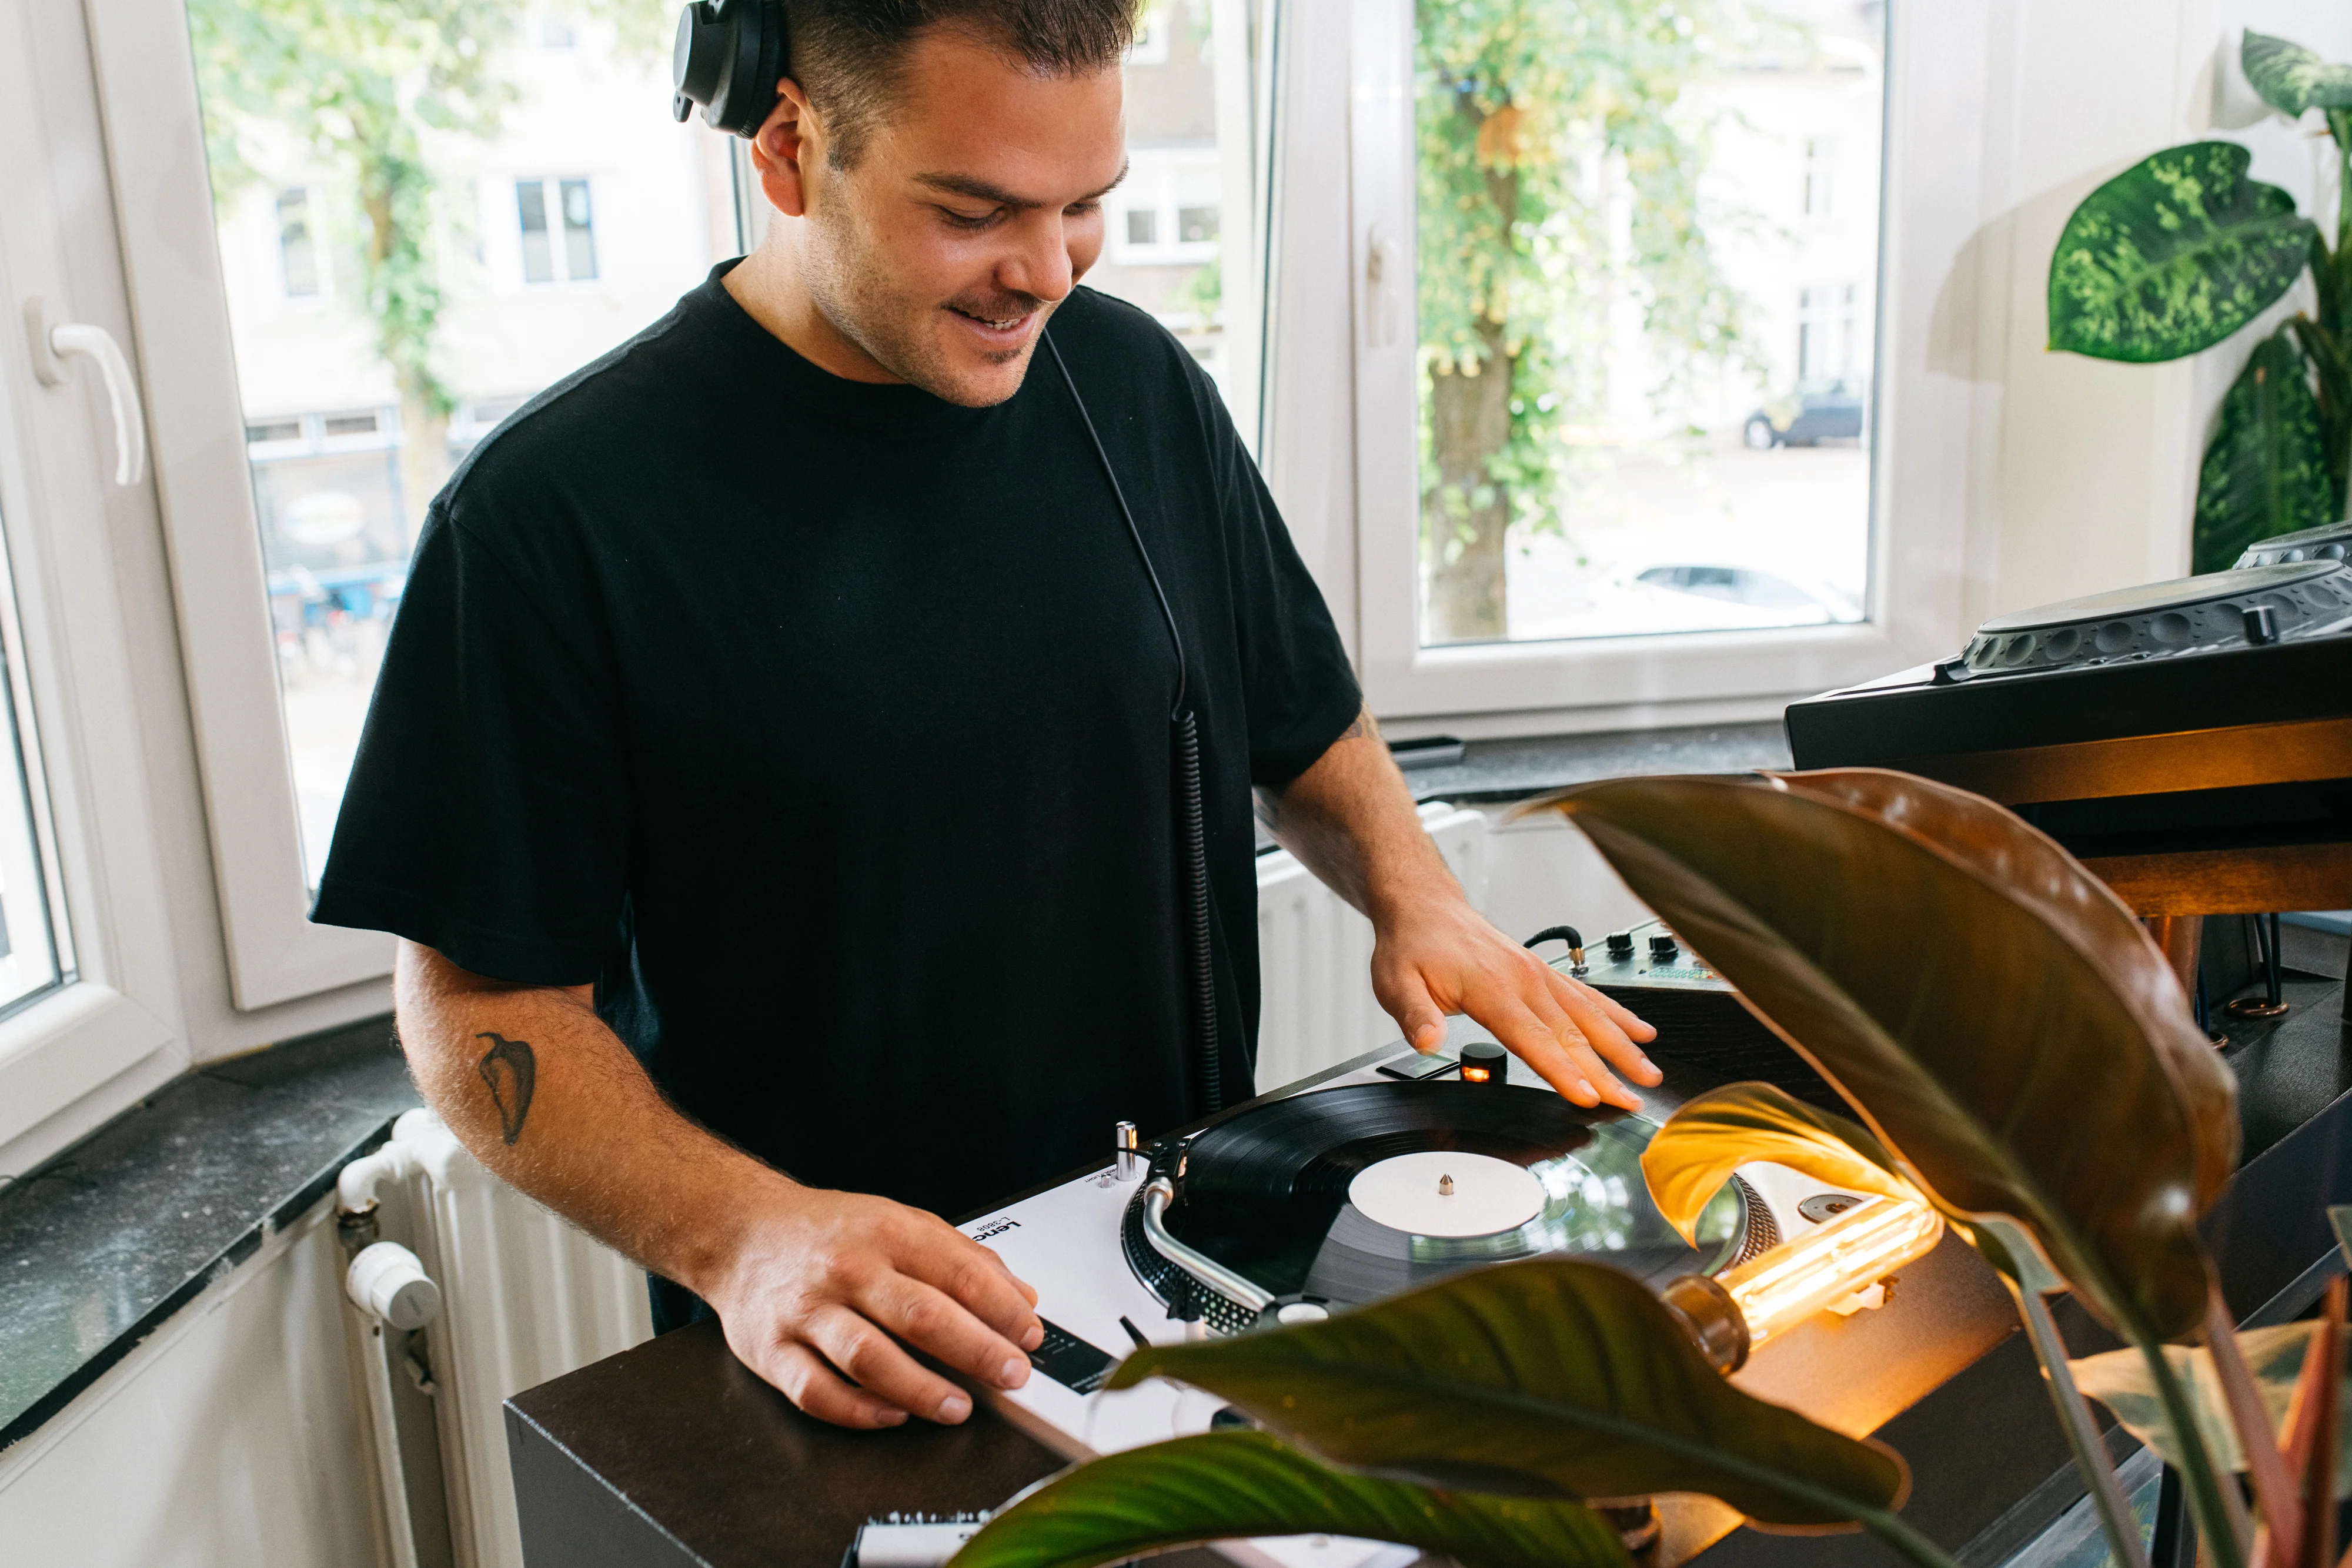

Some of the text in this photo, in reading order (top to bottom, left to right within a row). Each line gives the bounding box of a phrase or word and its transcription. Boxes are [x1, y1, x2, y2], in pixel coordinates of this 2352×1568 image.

[1084, 1175, 1101, 1183] LIGHT
[972, 1221, 1022, 1241] Lenc
[977, 1216, 1010, 1231] L-3808
